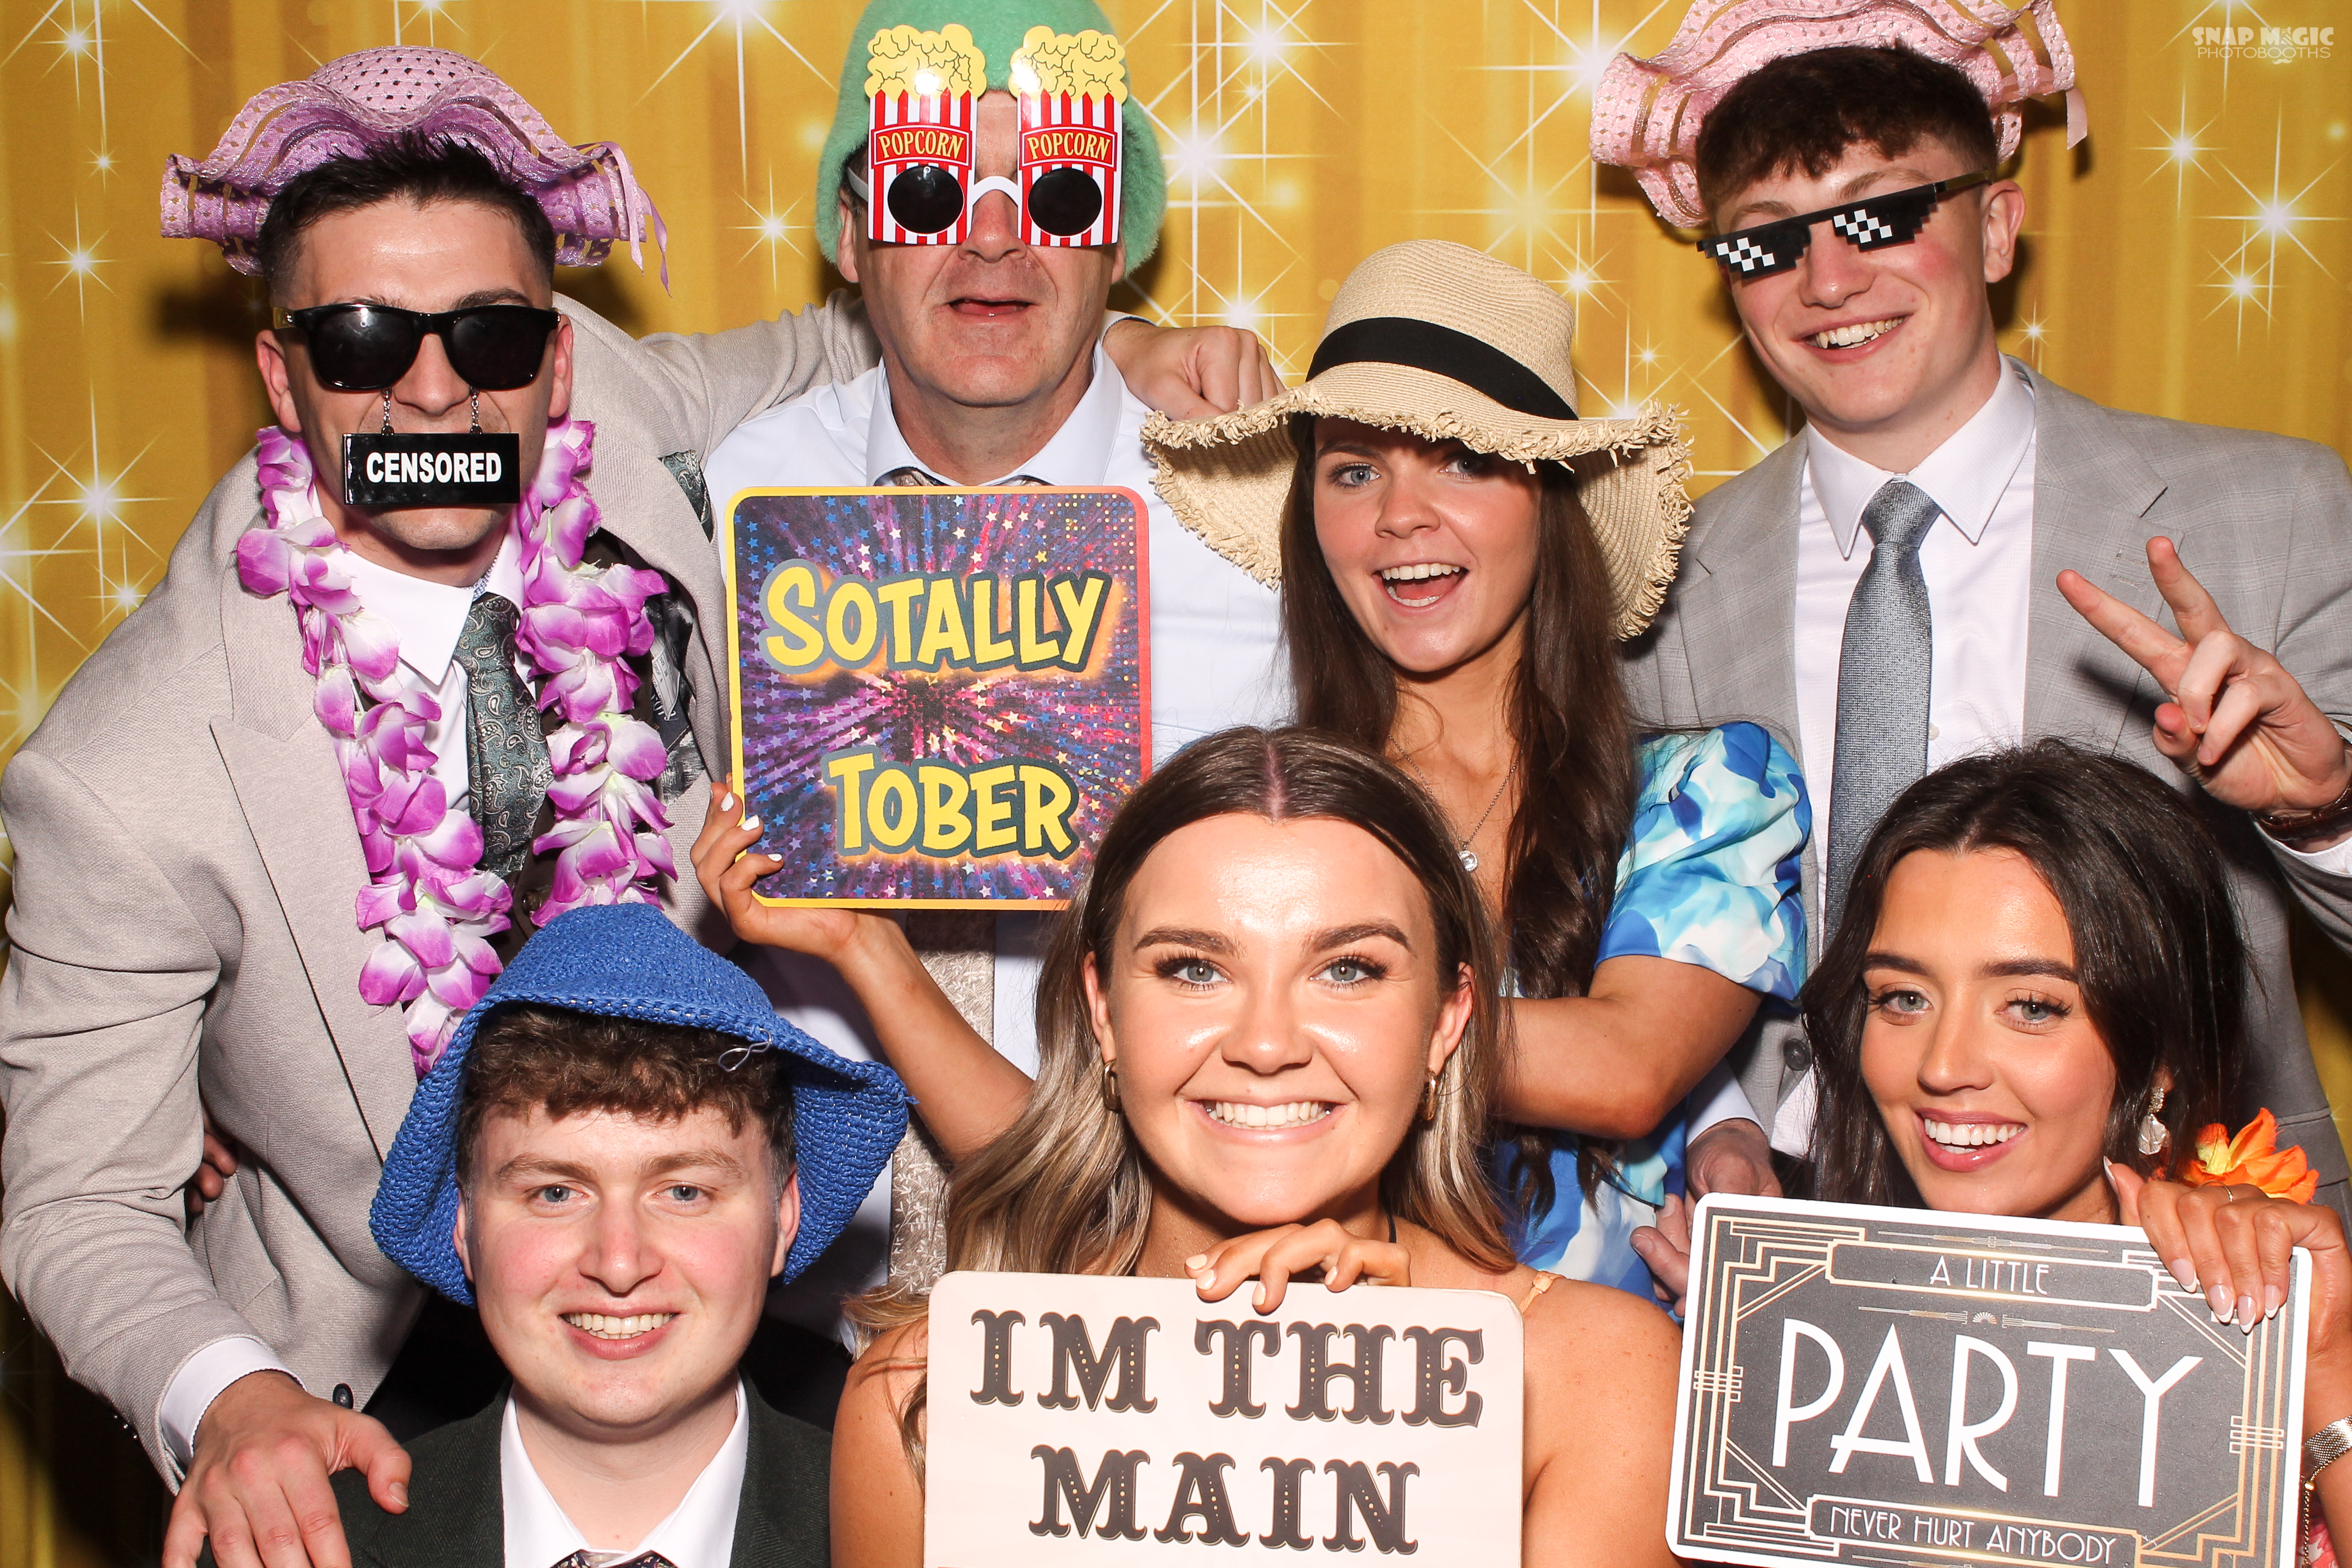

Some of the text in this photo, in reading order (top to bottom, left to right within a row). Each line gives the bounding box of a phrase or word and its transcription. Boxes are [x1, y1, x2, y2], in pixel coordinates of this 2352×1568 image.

[878, 130, 965, 159] POPCORN
[1027, 132, 1110, 160] POPCORN
[366, 451, 502, 483] CENSORED
[764, 564, 1106, 668] SOTALLY
[827, 752, 1072, 853] TOBER
[1929, 1255, 2050, 1296] A LITTLE
[970, 1309, 1484, 1429] IM THE
[1771, 1317, 2204, 1508] PARTY
[1028, 1444, 1420, 1556] MAIN
[1830, 1507, 2118, 1567] NEVER HURT ANYBODY
